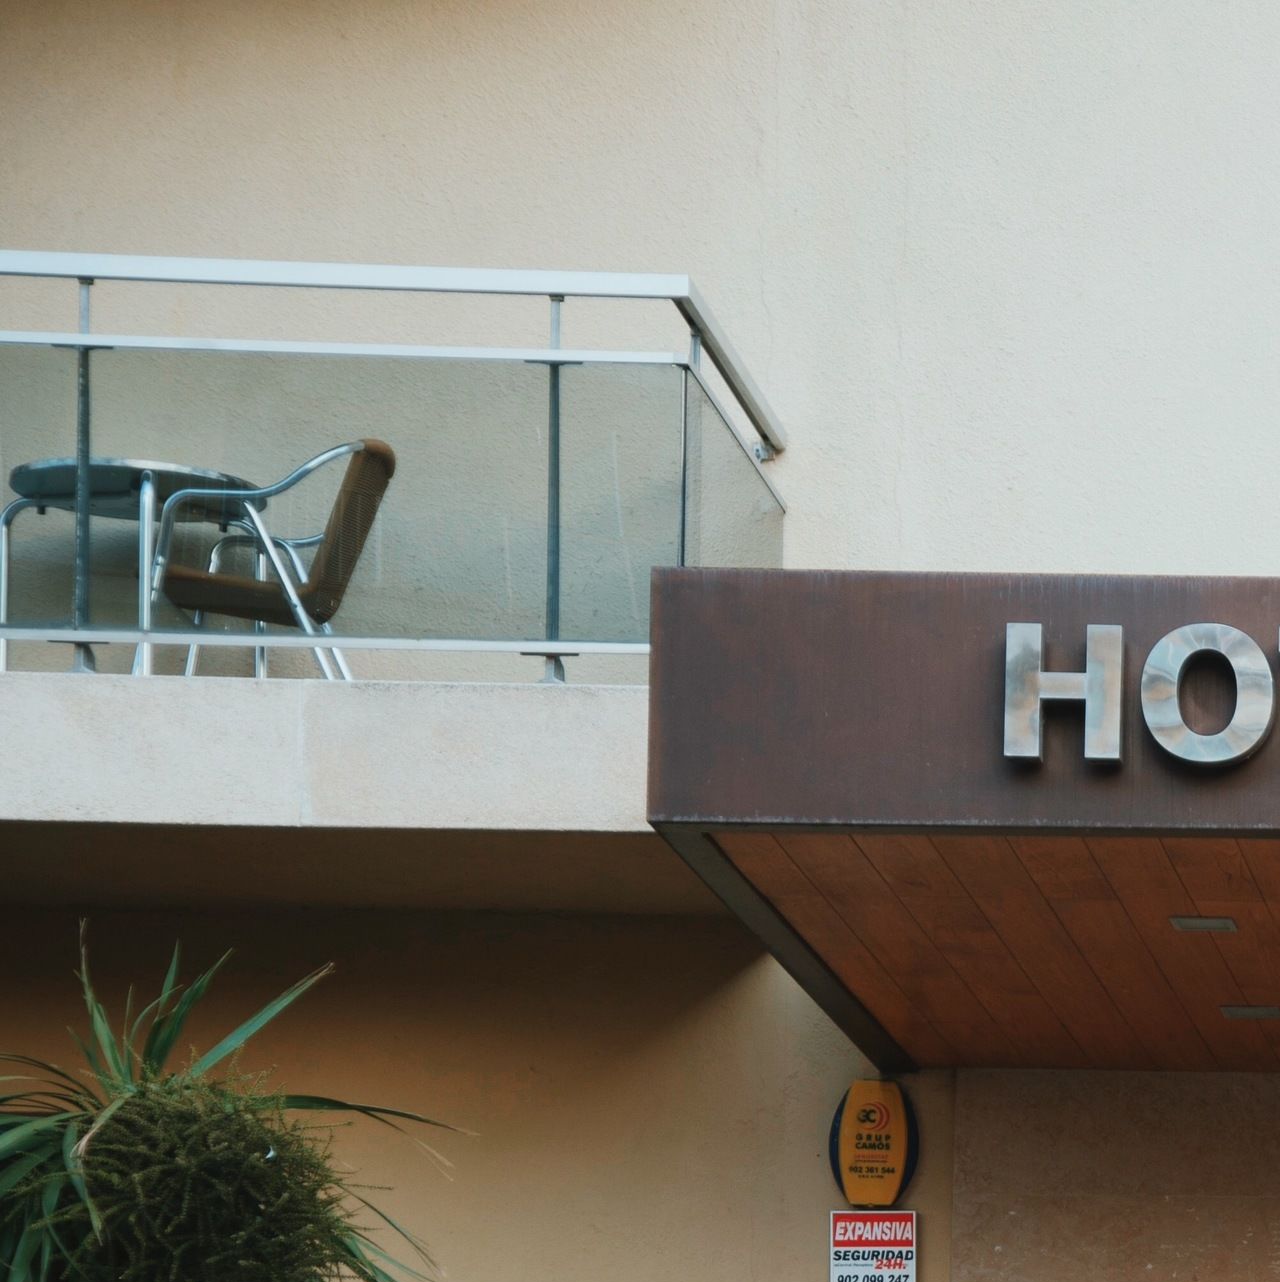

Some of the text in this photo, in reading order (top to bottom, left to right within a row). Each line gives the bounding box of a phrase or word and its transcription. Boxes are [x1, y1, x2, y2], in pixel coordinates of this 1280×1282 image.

[856, 1133, 891, 1141] GRUP
[834, 1221, 913, 1241] EXPANSIVA
[833, 1250, 914, 1260] SEGURIDAD
